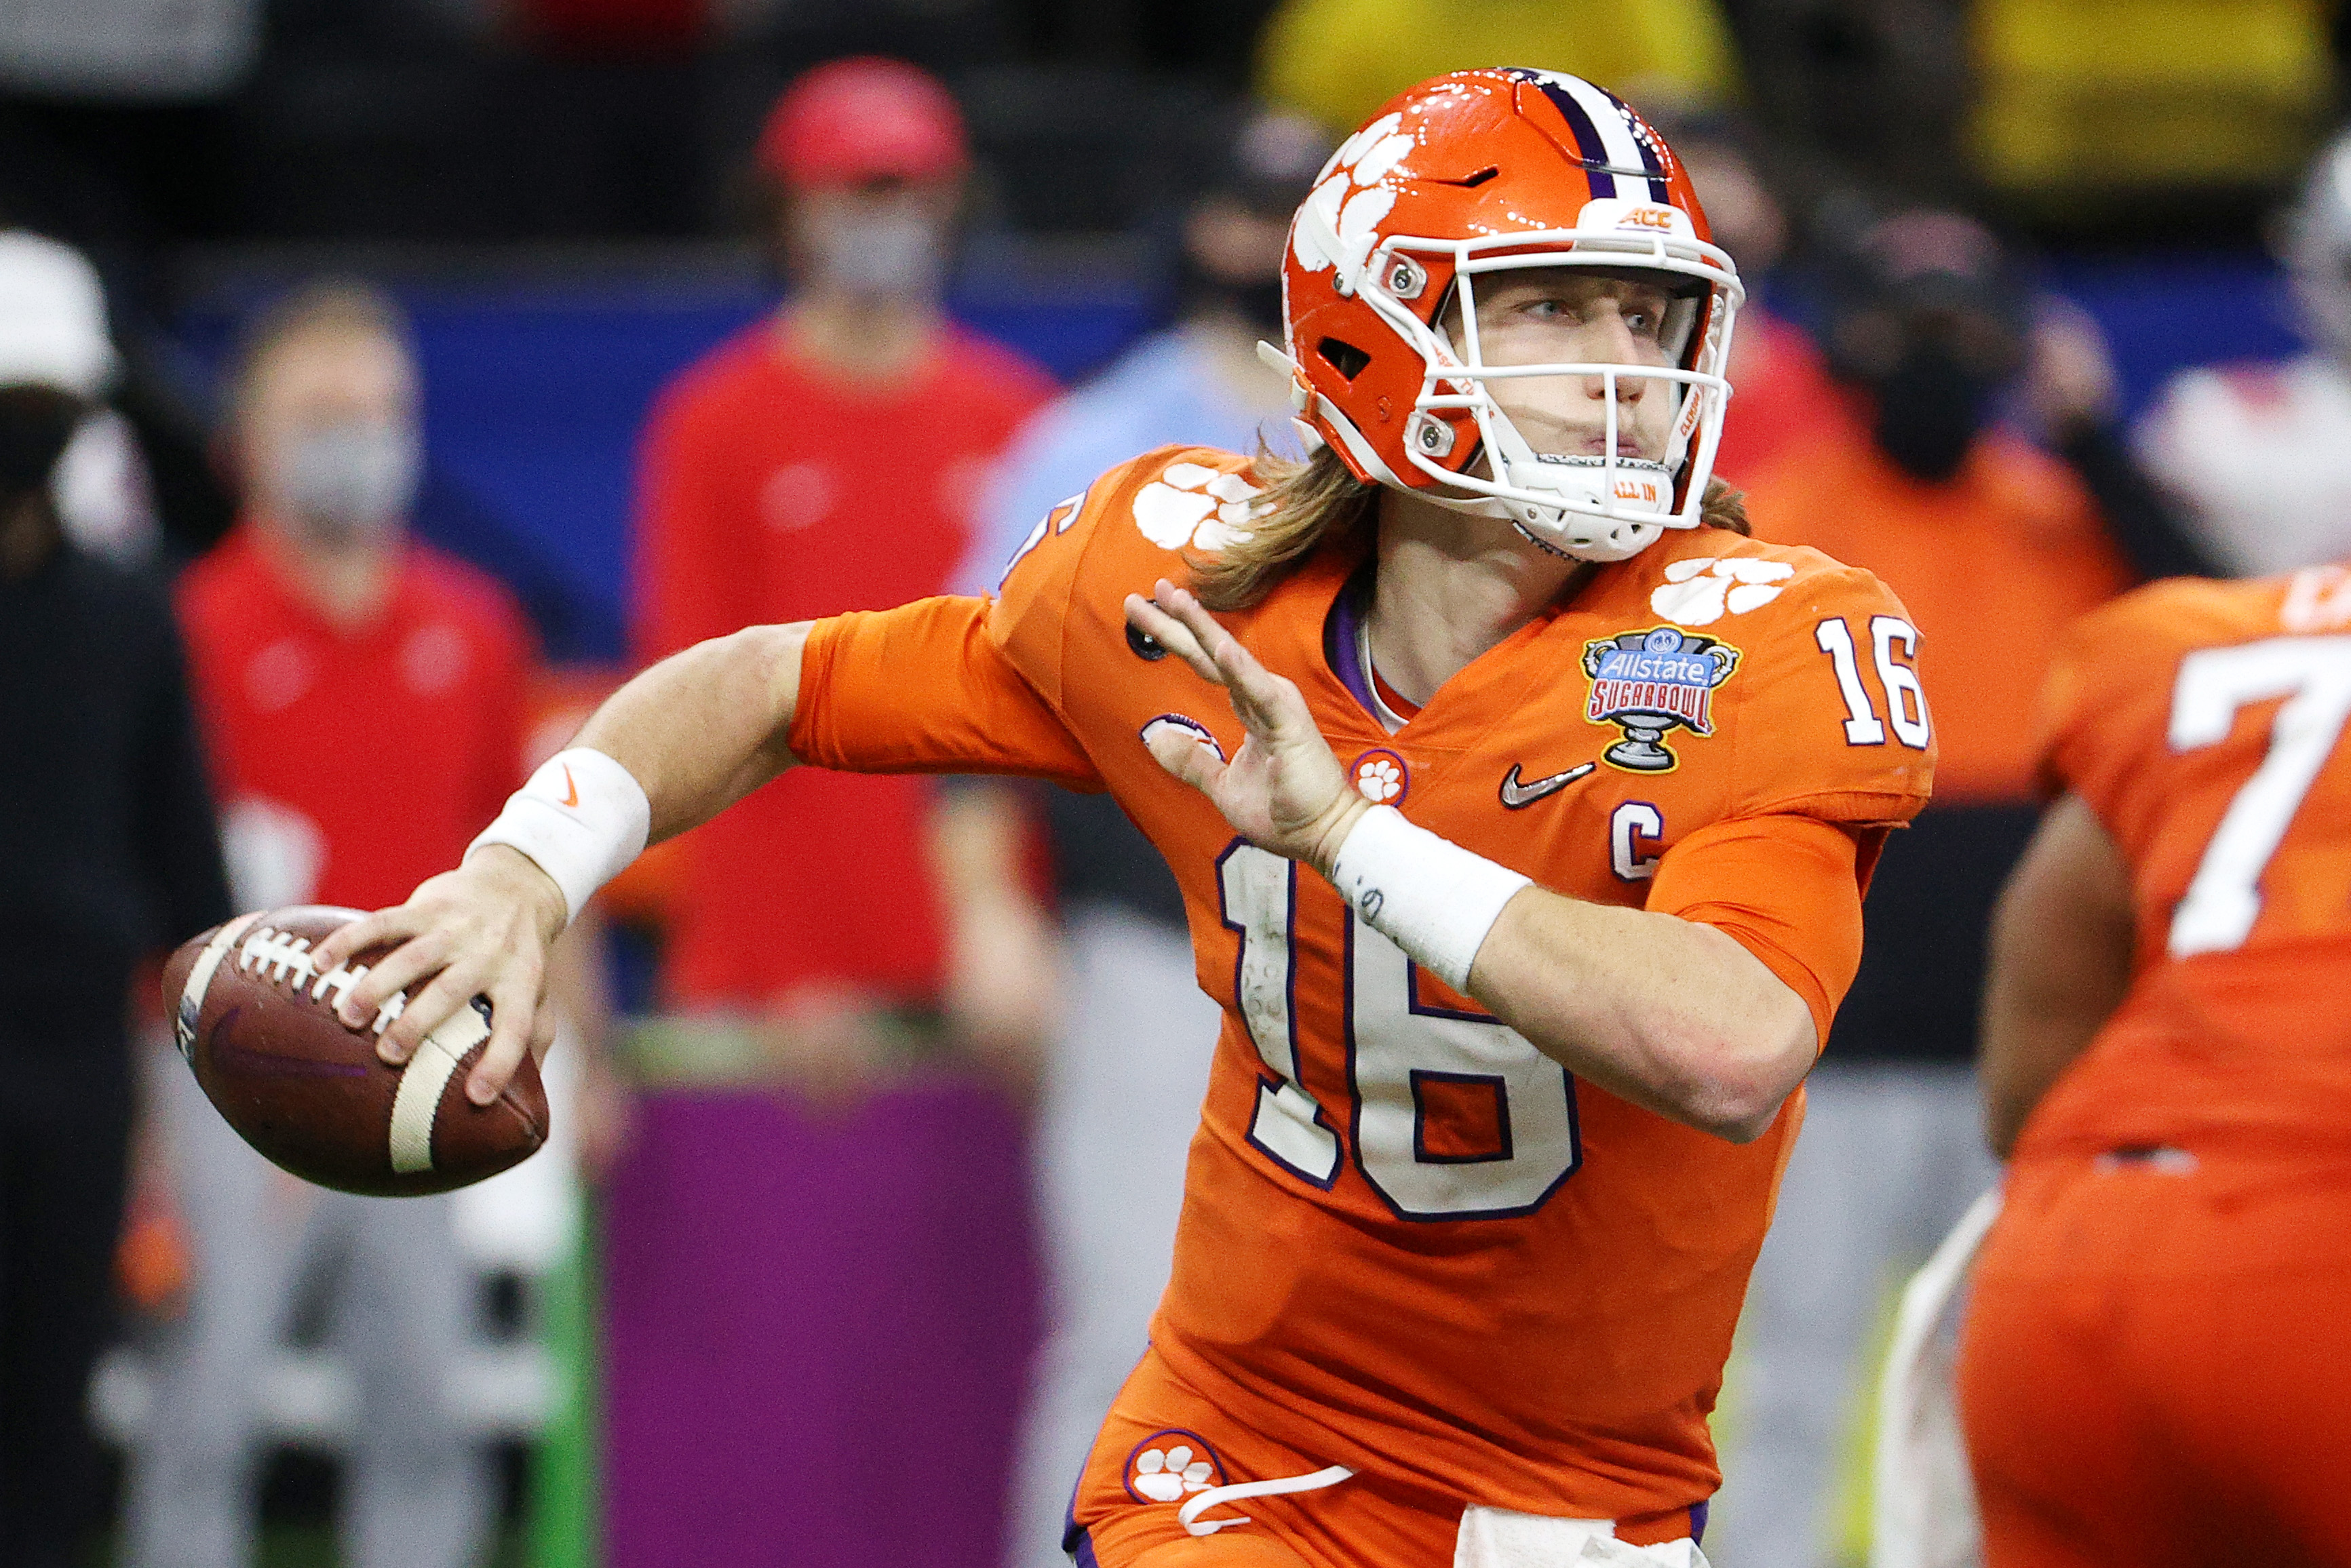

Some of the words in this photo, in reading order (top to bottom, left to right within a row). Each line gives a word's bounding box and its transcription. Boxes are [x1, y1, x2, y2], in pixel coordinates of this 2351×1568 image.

[1617, 207, 1672, 229] ACC
[1614, 480, 1640, 500] ALL
[1641, 482, 1656, 503] IN
[1602, 652, 1705, 682] Allstate
[1814, 614, 1930, 751] 16
[1610, 800, 1663, 883] C
[1215, 835, 1584, 1222] 16
